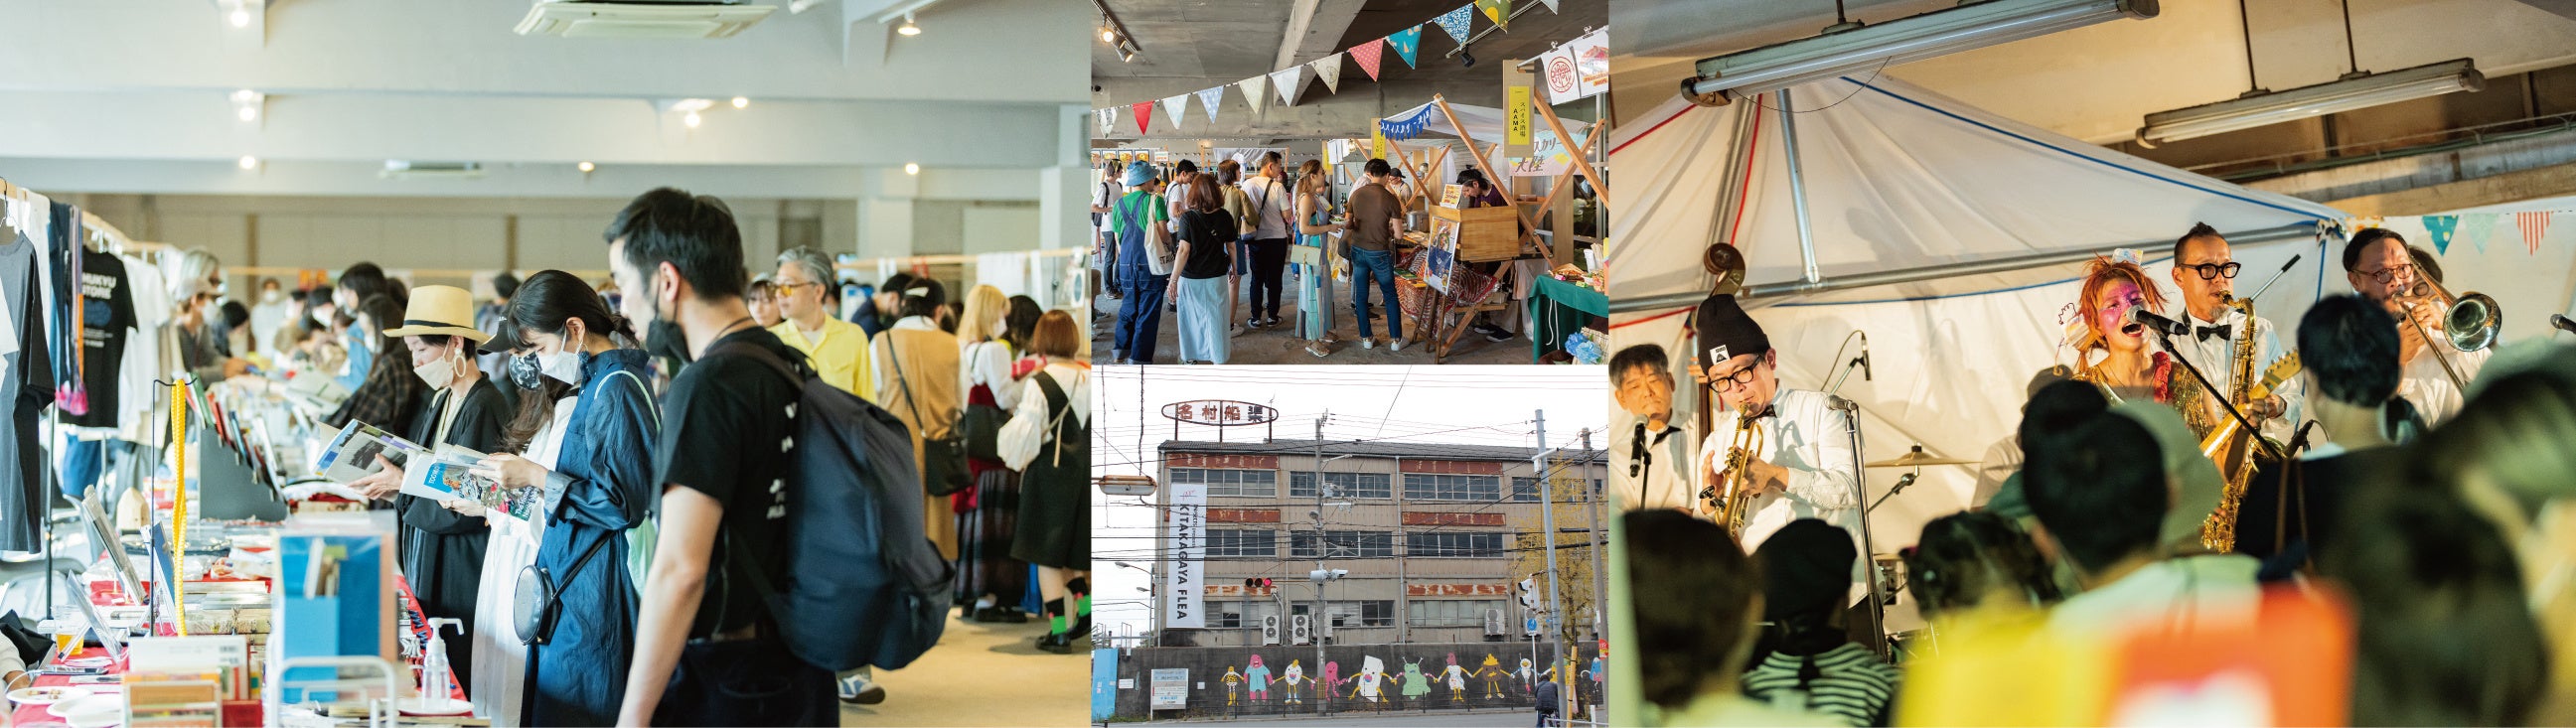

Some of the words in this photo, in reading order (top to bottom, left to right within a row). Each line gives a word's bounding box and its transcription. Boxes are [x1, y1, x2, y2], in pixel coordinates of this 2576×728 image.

[1178, 403, 1263, 423] 名村船渠
[1178, 504, 1189, 585] KITAKAGAYA
[1177, 590, 1187, 620] FLEA
